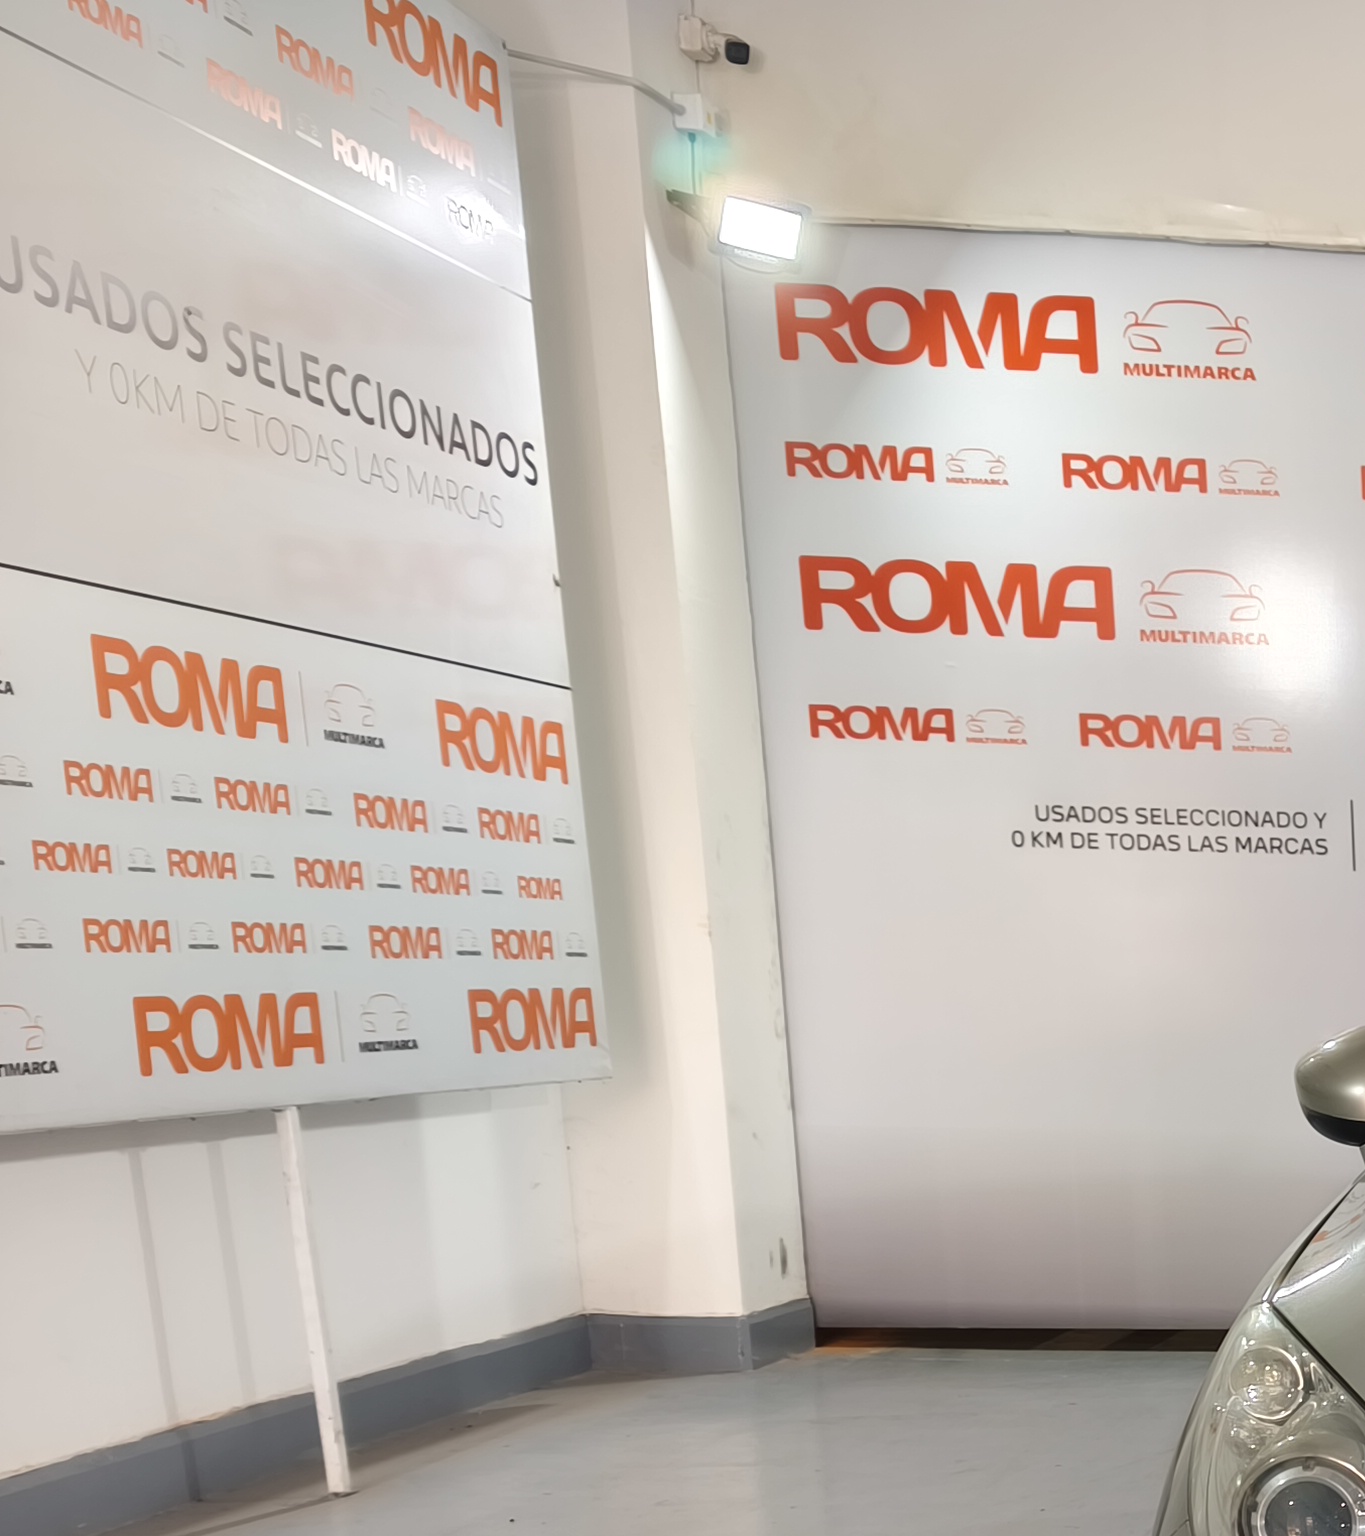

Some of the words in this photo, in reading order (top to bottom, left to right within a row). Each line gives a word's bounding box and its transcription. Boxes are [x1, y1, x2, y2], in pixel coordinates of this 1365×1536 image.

[275, 25, 355, 98] ROMA
[364, 0, 503, 128] ROMA
[206, 58, 281, 130] ROMA
[331, 128, 397, 193] ROMA
[775, 284, 1099, 375] ROMA
[1123, 363, 1257, 382] MULTIMARCA
[222, 321, 539, 487] SELECCIONADOS
[74, 348, 97, 394] Y
[197, 390, 241, 443] DE
[246, 409, 348, 478] TODAS
[355, 445, 400, 495] LAS
[408, 465, 505, 529] MARCAS
[784, 441, 935, 484] ROMA
[1061, 453, 1208, 495] ROMA
[799, 555, 1116, 642] ROMA
[1139, 630, 1268, 646] MULTIMARCA
[90, 634, 289, 745] ROMA
[435, 700, 569, 785] ROMA
[808, 704, 956, 744] ROMA
[1079, 713, 1223, 753] ROMA
[63, 760, 154, 803] ROMA
[214, 776, 291, 816] ROMA
[354, 793, 428, 834] ROMA
[478, 807, 541, 845] ROMA
[1034, 805, 1128, 824] USADOS
[1135, 808, 1307, 829] SELECCIONADO
[1314, 813, 1327, 829] Y
[32, 840, 113, 875] ROMA
[1031, 831, 1064, 848] KM
[1070, 832, 1100, 850] DE
[1109, 833, 1181, 852] TODAS
[1188, 836, 1228, 853] LAS
[1235, 837, 1329, 855] MARCAS
[167, 848, 238, 881] ROMA
[295, 857, 364, 892] ROMA
[411, 865, 471, 897] ROMA
[517, 876, 563, 901] ROMA
[82, 918, 172, 955] ROMA
[231, 921, 307, 955] ROMA
[369, 925, 443, 960] ROMA
[492, 929, 555, 961] ROMA
[132, 993, 325, 1078] ROMA
[468, 988, 598, 1055] ROMA
